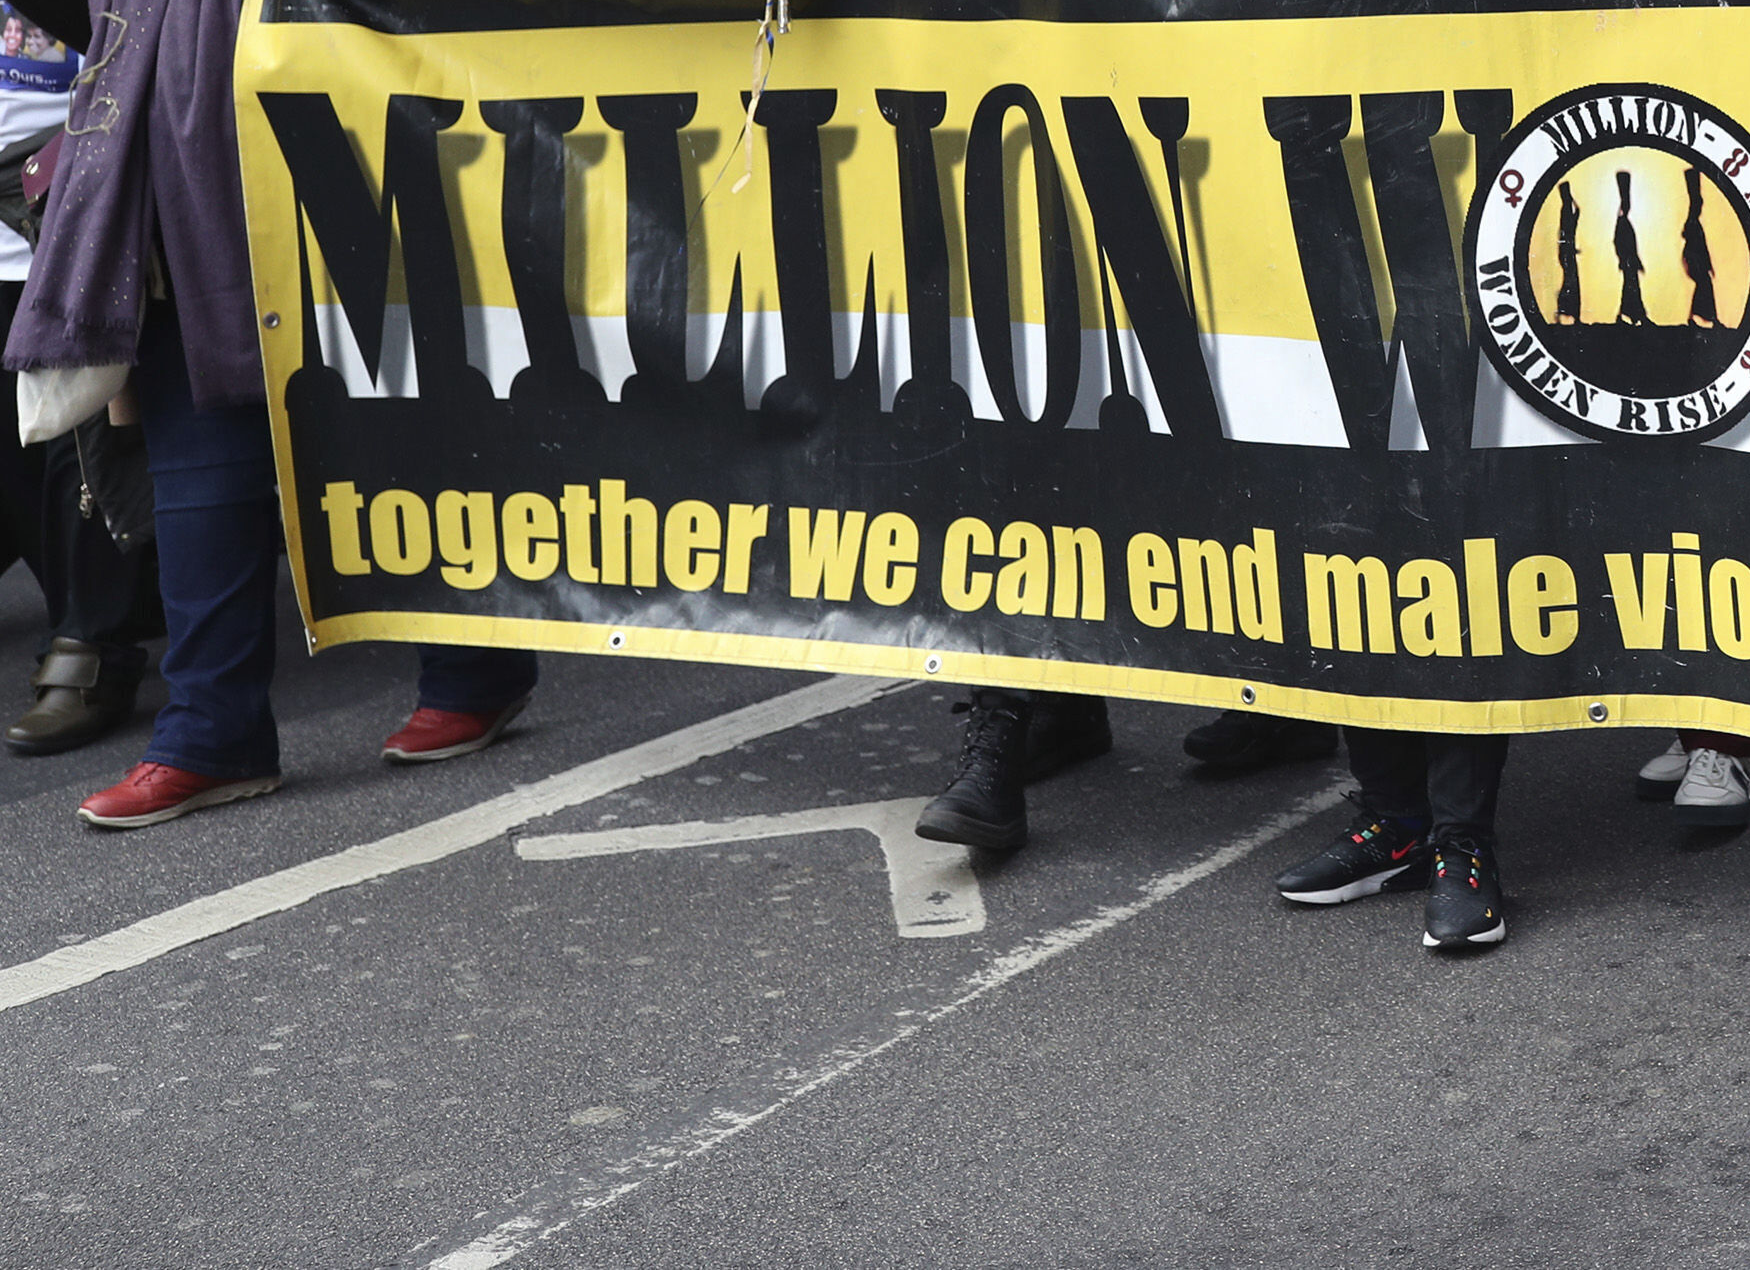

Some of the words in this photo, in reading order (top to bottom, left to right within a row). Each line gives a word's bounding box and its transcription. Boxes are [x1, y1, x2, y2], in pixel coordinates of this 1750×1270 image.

[257, 83, 1226, 445] MILLION
[1479, 255, 1600, 419] WOMEN
[320, 479, 769, 595] together
[788, 506, 919, 607] we
[940, 516, 1106, 622] can
[1126, 526, 1285, 645] end
[1303, 538, 1579, 658] male
